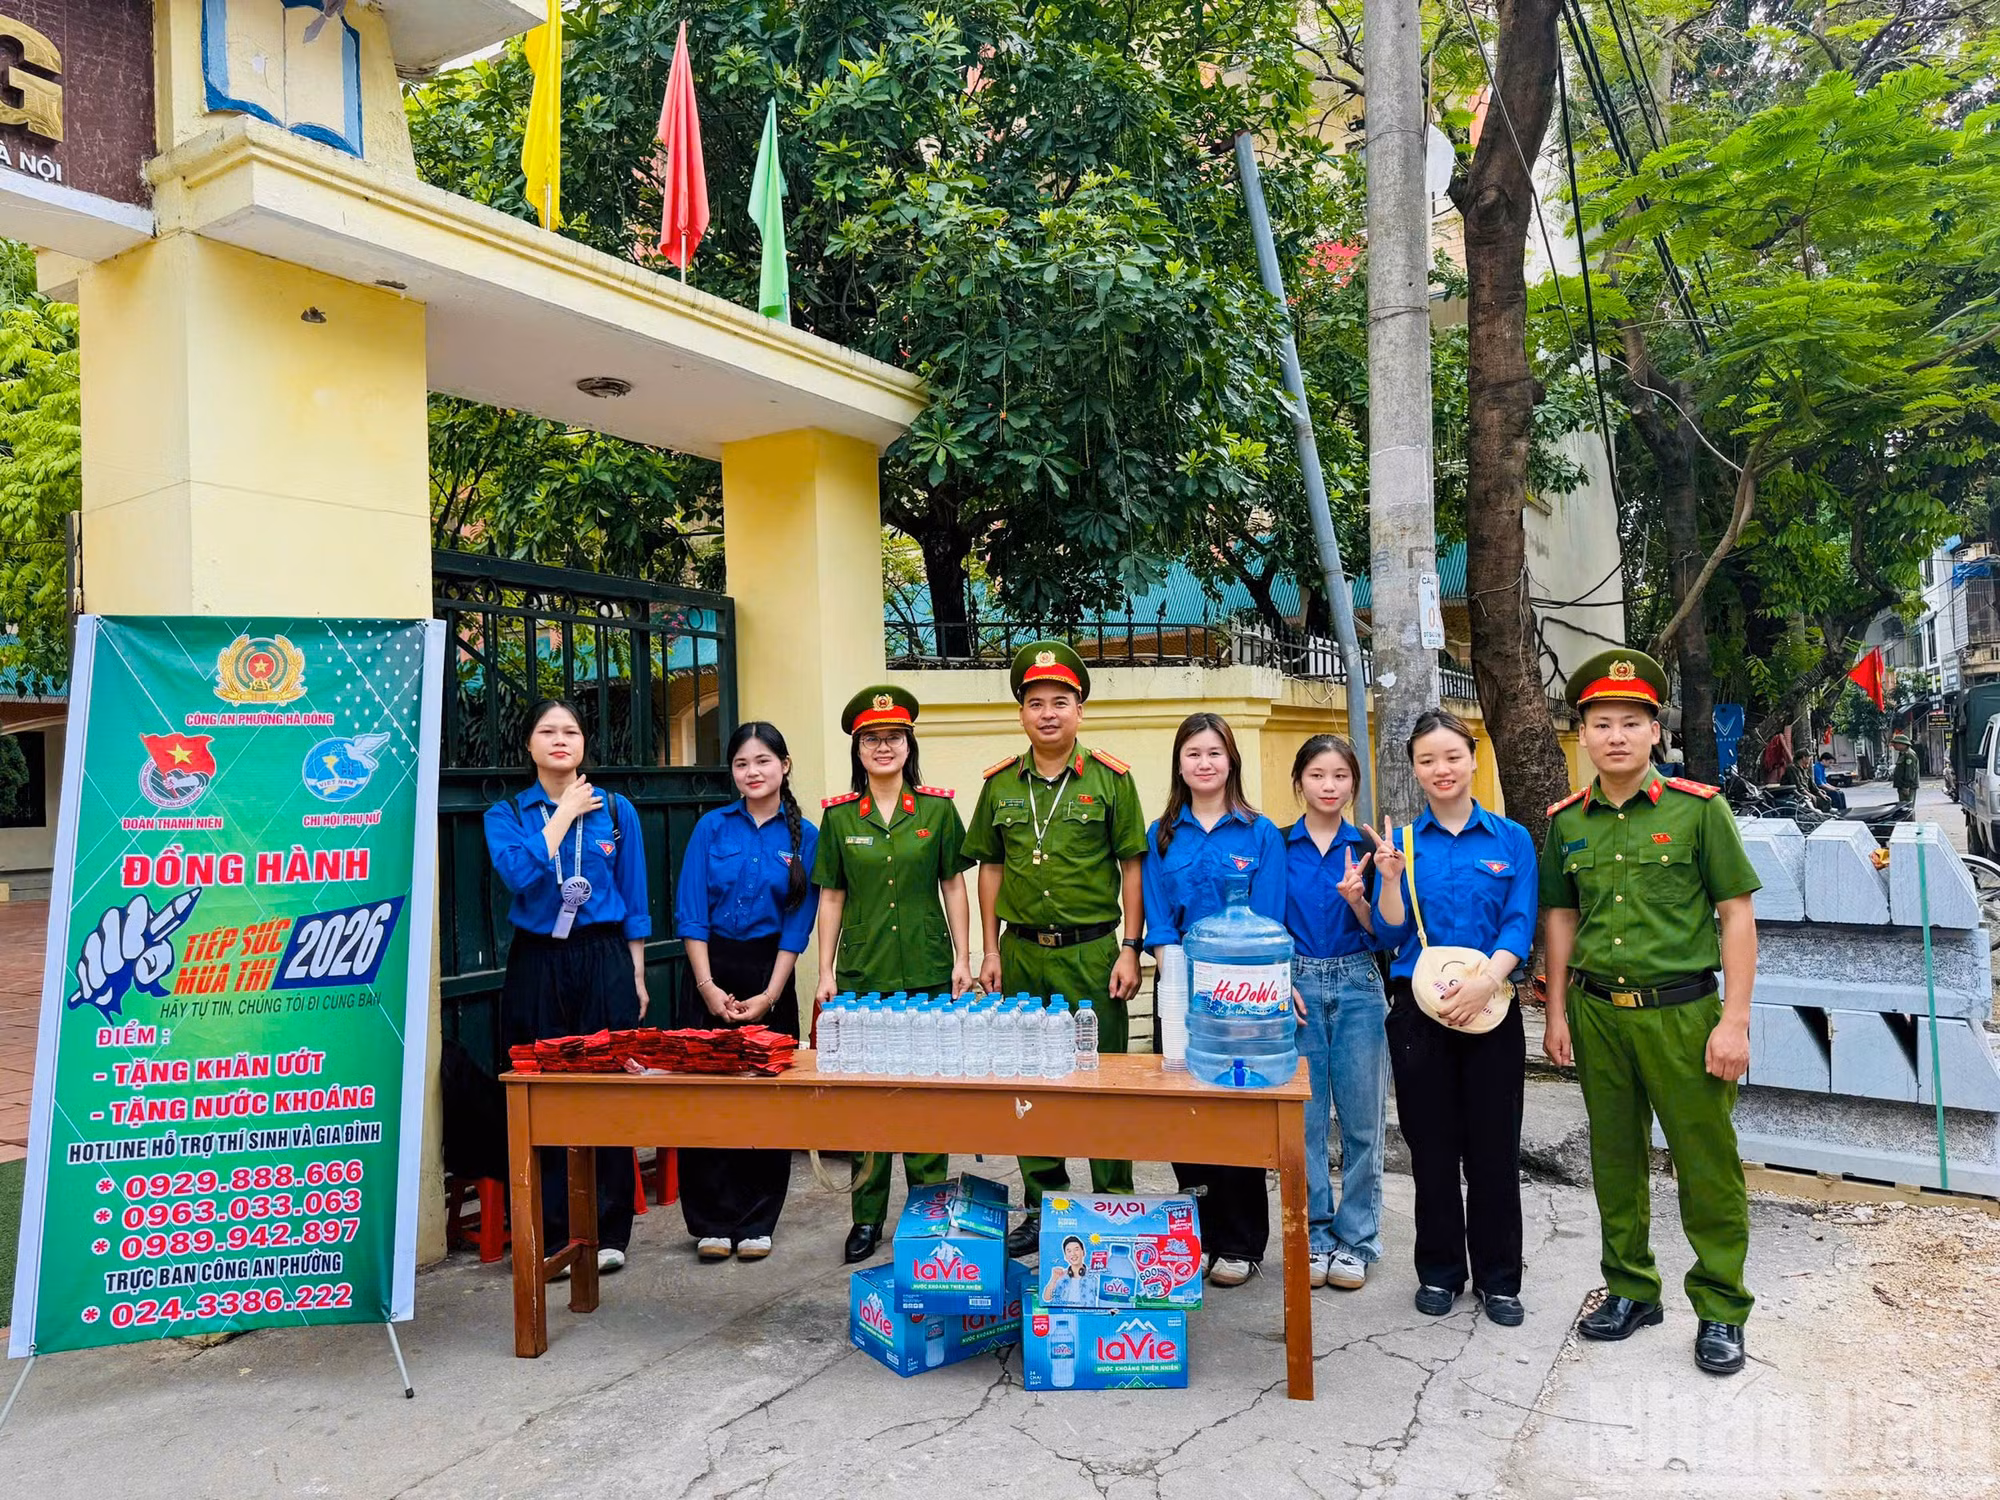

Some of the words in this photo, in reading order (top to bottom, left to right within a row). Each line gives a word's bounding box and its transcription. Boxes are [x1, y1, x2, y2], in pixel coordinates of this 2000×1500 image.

[20, 151, 62, 182] NỘI
[186, 711, 217, 725] CÔNG
[219, 713, 237, 725] AN
[238, 710, 284, 725] PHƯỜNG
[285, 711, 301, 725] HÀ
[303, 711, 334, 725] ĐÔNG
[122, 816, 154, 829] ĐOÀN
[157, 818, 193, 829] THANH
[196, 816, 223, 829] NIÊN
[303, 815, 321, 827] CHI
[323, 812, 340, 829] HỘI
[342, 813, 363, 828] PHỤ
[121, 844, 245, 887] ĐỒNG
[256, 844, 370, 884] HÀNH
[183, 924, 239, 963] TIẾP
[240, 917, 292, 957] SỨC
[284, 903, 393, 979] 2026
[174, 961, 231, 995] MÙA
[234, 958, 278, 993] THI
[1211, 979, 1278, 1003] HaDoWa
[160, 999, 188, 1019] HÃY
[191, 999, 210, 1020] TỰ
[212, 1000, 234, 1017] TIN,
[238, 996, 282, 1014] CHÚNG
[286, 992, 305, 1011] TÔI
[307, 995, 320, 1010] ĐI
[322, 990, 355, 1010] CÙNG
[97, 1020, 155, 1047] ĐIỂM
[113, 1058, 188, 1088] TẶNG
[196, 1052, 269, 1080] KHĂN
[276, 1047, 325, 1075] ƯỚT
[111, 1098, 186, 1128] TẶNG
[194, 1089, 268, 1118] NƯỚC
[275, 1085, 375, 1113] KHOÁNG
[68, 1140, 147, 1164] HOTLINE
[151, 1132, 175, 1157] HỖ
[180, 1134, 215, 1160] TRỢ
[218, 1128, 245, 1153] THÍ
[249, 1130, 288, 1151] SINH
[293, 1126, 312, 1148] VÀ
[315, 1125, 342, 1146] GIA
[344, 1121, 382, 1144] ĐÌNH
[124, 1159, 364, 1200] 0929.888.666
[122, 1188, 361, 1230] 0963.033.063
[1094, 1201, 1146, 1217] laVie
[119, 1218, 360, 1260] 0989.942.897
[105, 1264, 154, 1295] TRỰC
[158, 1264, 197, 1287] BAN
[200, 1258, 249, 1283] CÔNG
[252, 1256, 279, 1278] AN
[279, 1248, 342, 1276] PHƯỜNG
[913, 1256, 980, 1281] laVie
[110, 1283, 353, 1329] 024.3386.222
[1104, 1282, 1131, 1295] laVie
[859, 1299, 893, 1337] laVie
[1098, 1332, 1177, 1361] laVie
